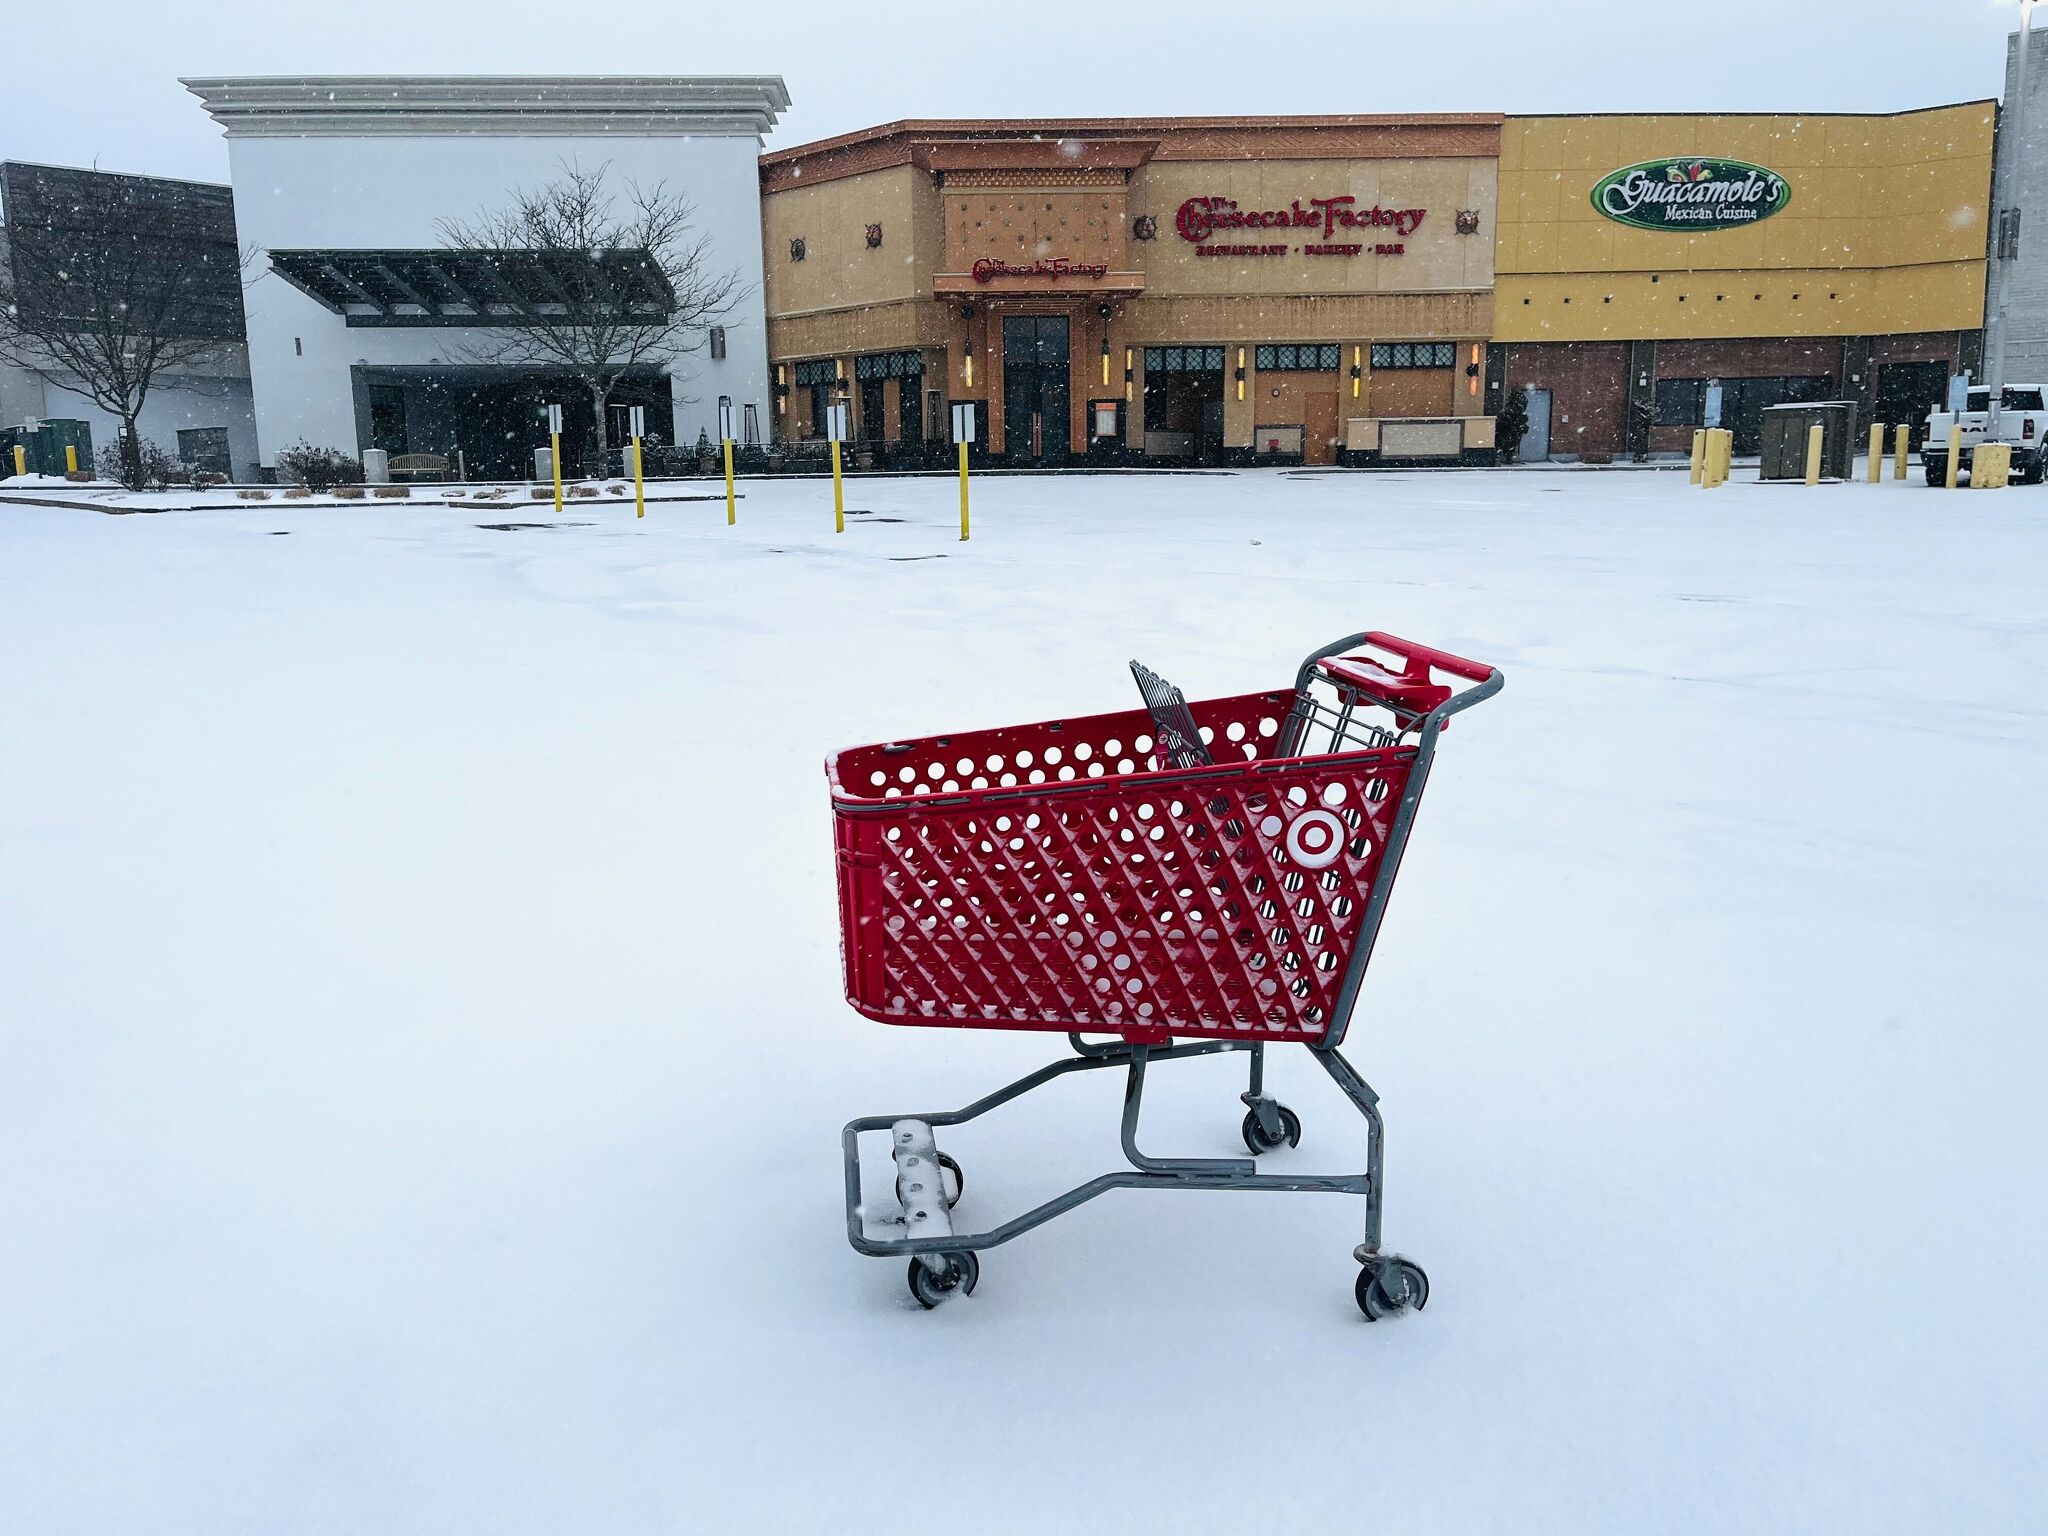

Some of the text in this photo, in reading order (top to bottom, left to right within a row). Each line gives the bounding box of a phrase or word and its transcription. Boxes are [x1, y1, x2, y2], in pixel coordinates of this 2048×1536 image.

[1603, 171, 1782, 215] Guacamole's
[1177, 196, 1427, 242] The Cheesecake Factory
[1664, 204, 1757, 221] Mexican Cuisine
[1305, 245, 1362, 256] BAKERY
[1376, 244, 1404, 255] BAR
[1045, 258, 1108, 281] Factory
